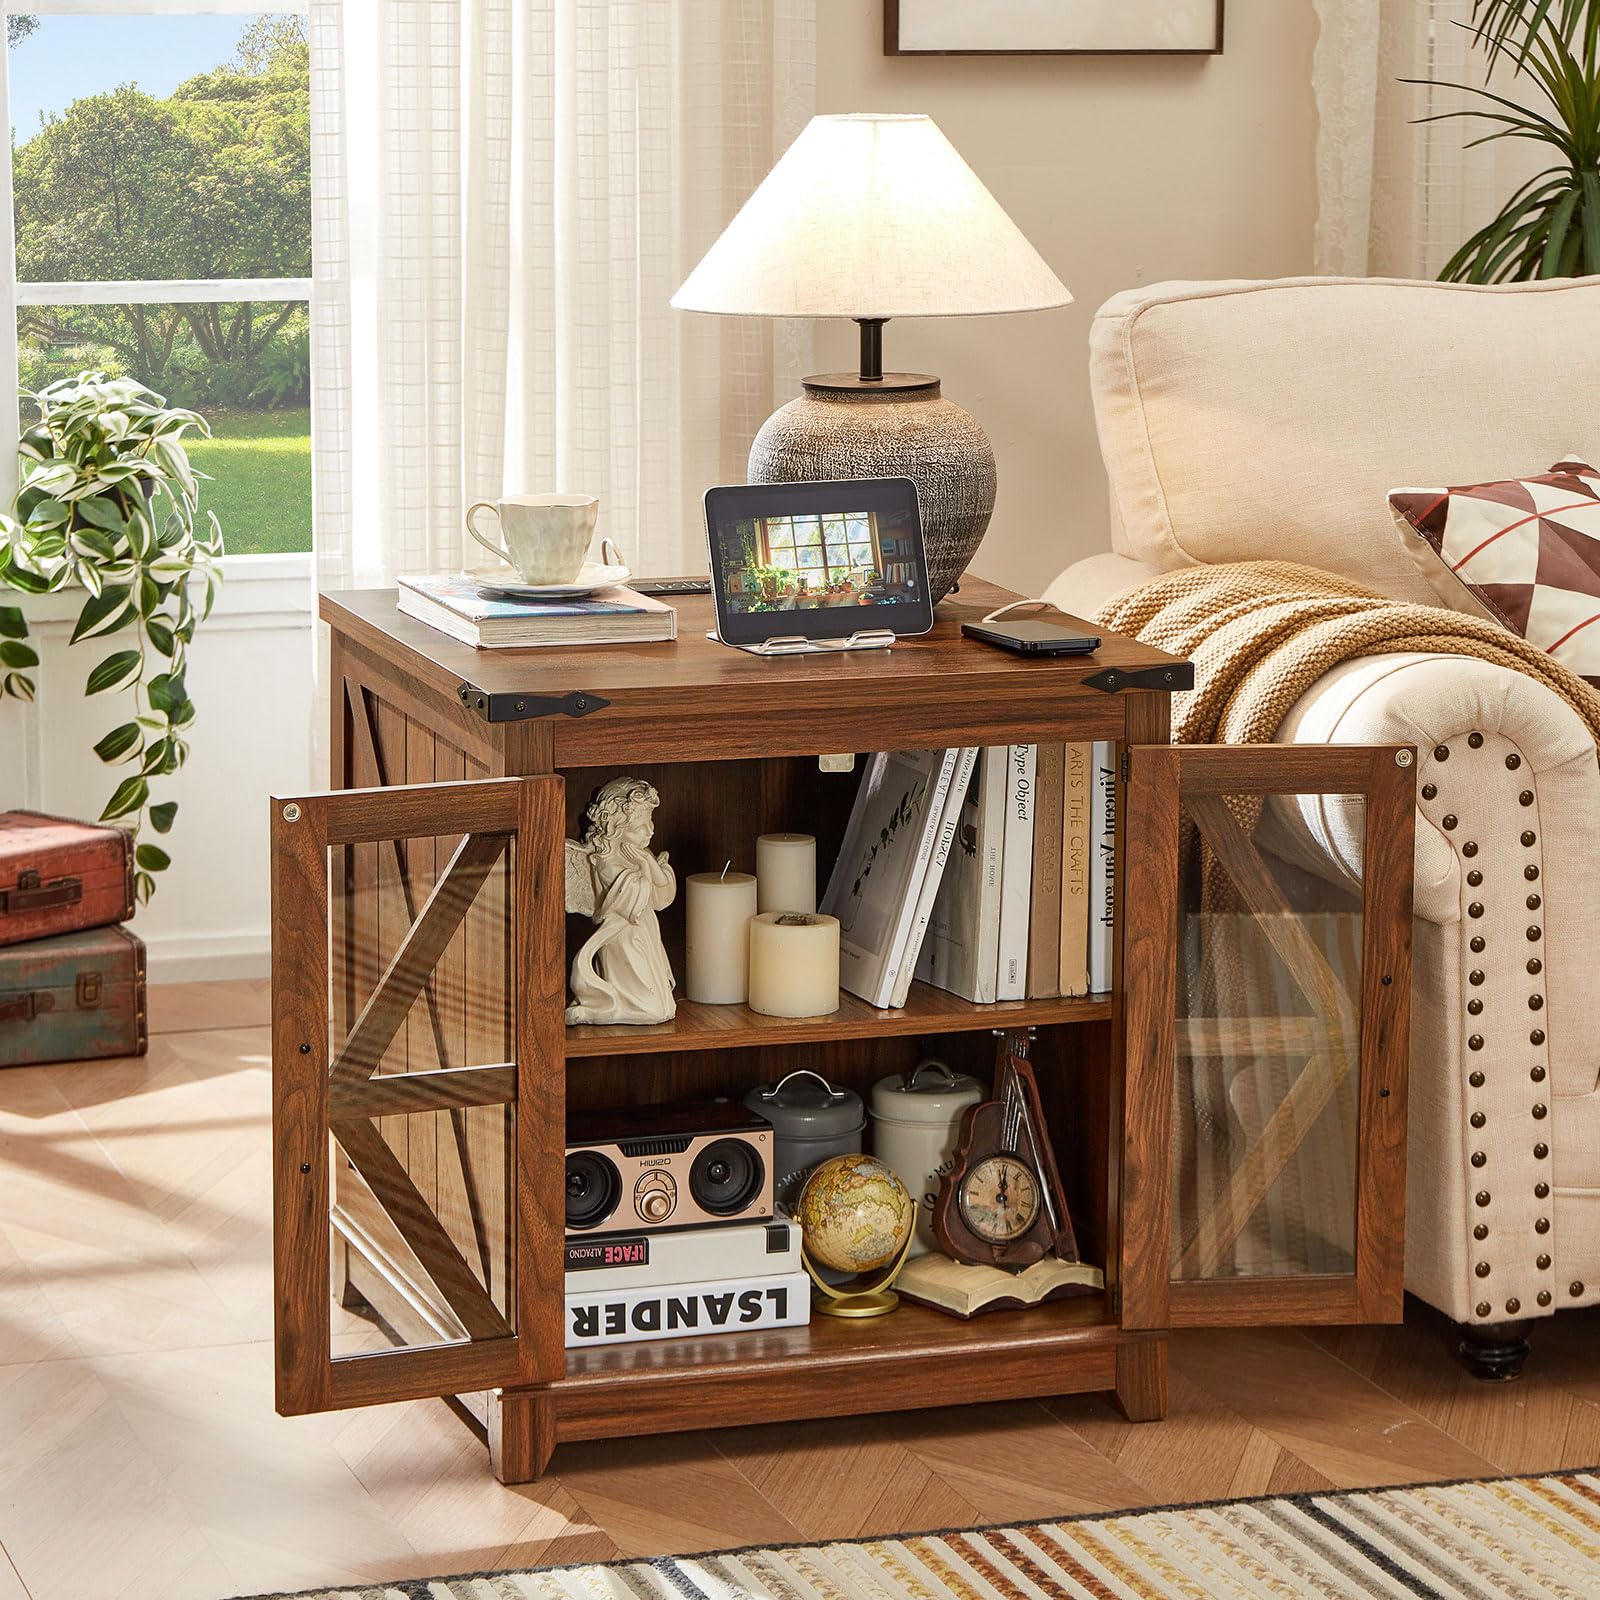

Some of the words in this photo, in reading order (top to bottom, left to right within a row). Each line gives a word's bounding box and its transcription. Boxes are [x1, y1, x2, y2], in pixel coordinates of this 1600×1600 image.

[1014, 744, 1029, 775] Type
[1070, 748, 1084, 788] ARTS
[1014, 778, 1030, 821] Object
[1070, 796, 1084, 828] THE
[1070, 836, 1084, 895] CRAFTS
[571, 1287, 788, 1338] LSANDER
